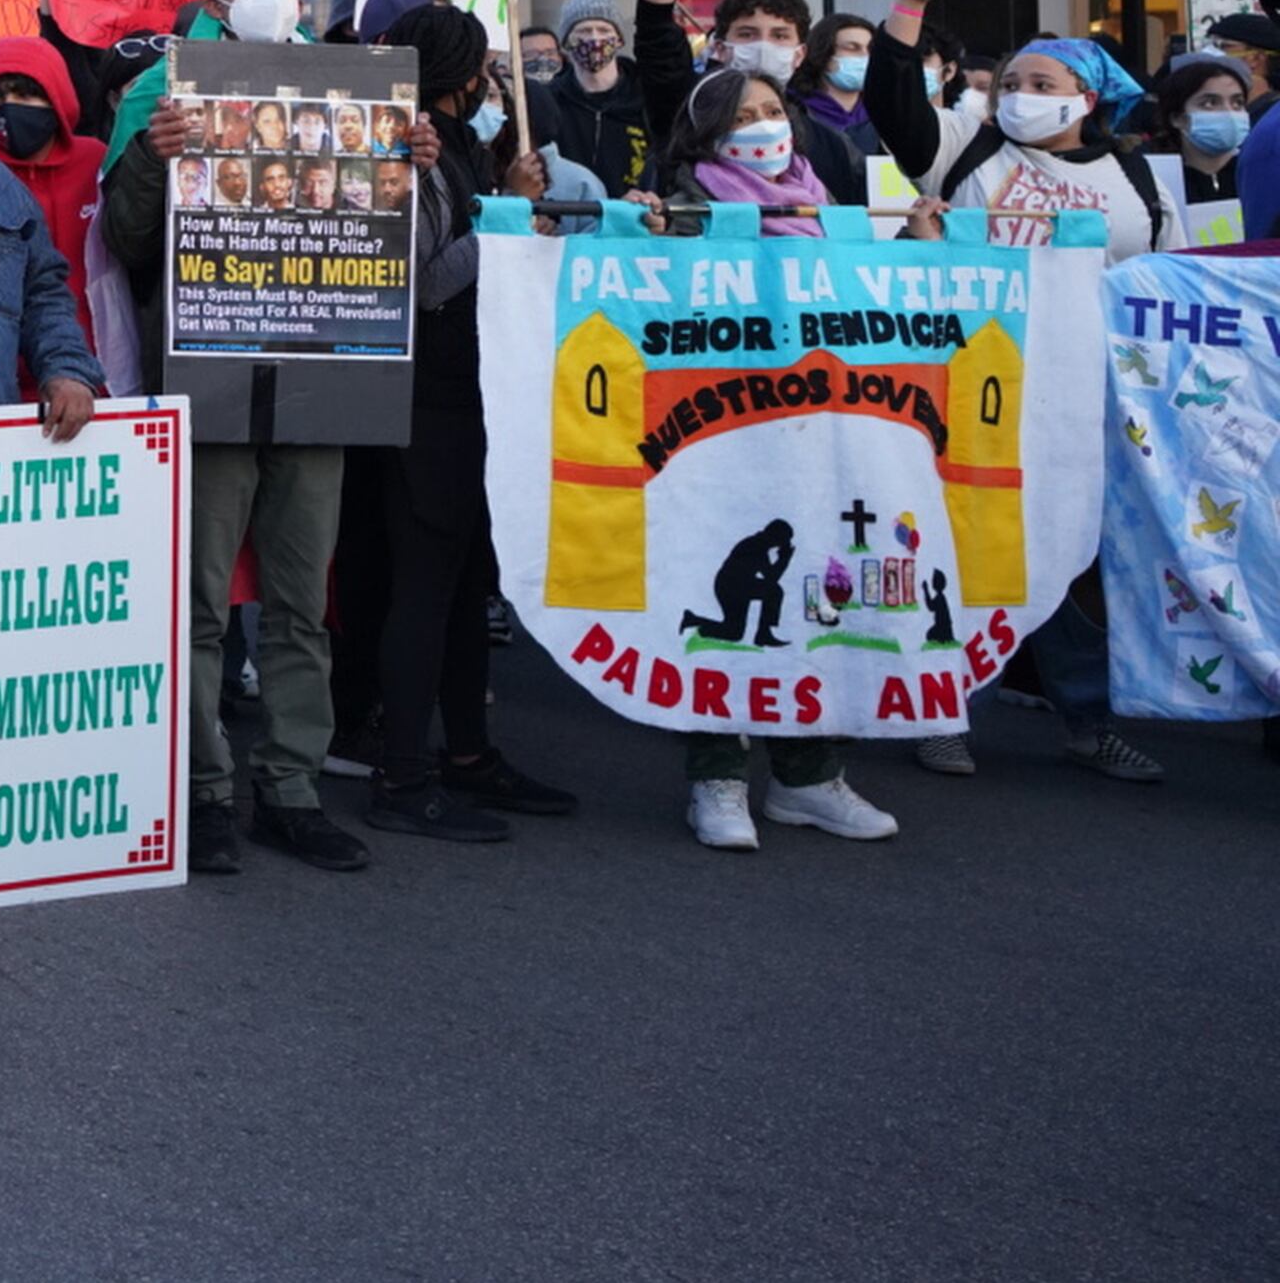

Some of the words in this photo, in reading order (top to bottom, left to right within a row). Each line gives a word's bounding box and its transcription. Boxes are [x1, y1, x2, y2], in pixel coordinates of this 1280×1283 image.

[178, 217, 214, 233] How
[219, 218, 258, 236] Many
[265, 219, 304, 235] More
[308, 219, 339, 236] Will
[343, 220, 369, 236] Die
[178, 233, 196, 249] At
[200, 234, 225, 250] the
[229, 234, 277, 251] Hands
[281, 235, 298, 251] of
[300, 237, 324, 253] the
[328, 238, 383, 254] Police?
[178, 254, 216, 282] We
[224, 255, 274, 289] Say:
[282, 256, 314, 284] NO
[321, 258, 405, 287] MORE!!
[690, 260, 758, 306] EN
[782, 257, 837, 304] LA
[855, 265, 1029, 314] VILITA
[178, 287, 204, 300] This
[207, 288, 252, 303] System
[301, 306, 332, 319] REAL
[642, 311, 776, 356] SEÑOR
[1124, 295, 1242, 347] THE
[636, 369, 832, 474] NUESTROS
[571, 622, 823, 724] PADRES
[876, 607, 1016, 721] ANES
